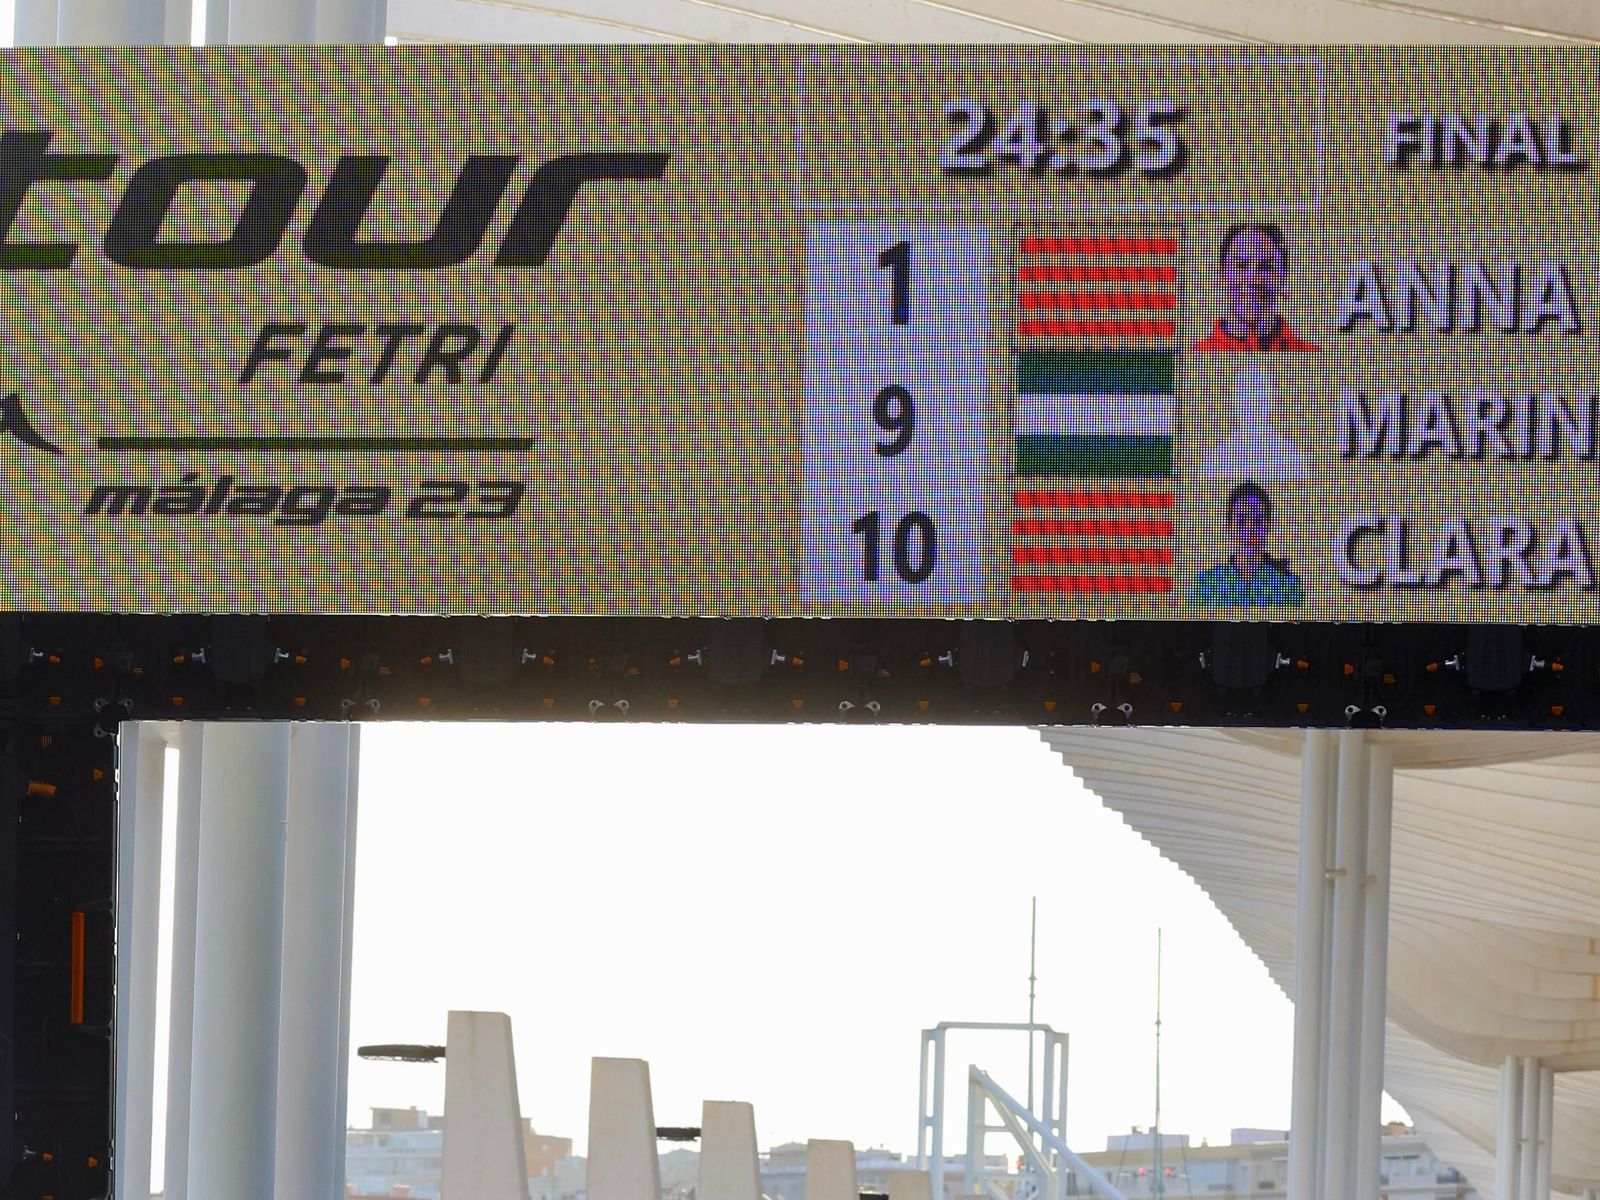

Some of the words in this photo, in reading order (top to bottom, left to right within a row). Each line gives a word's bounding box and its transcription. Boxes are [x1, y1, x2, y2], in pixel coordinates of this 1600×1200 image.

[941, 98, 1189, 177] 24:35
[1382, 111, 1587, 169] FINAL
[0, 131, 671, 269] tour
[877, 240, 912, 325] 1
[1338, 257, 1583, 334] ANNA
[239, 322, 515, 384] FETRI
[873, 385, 916, 458] 9
[1336, 387, 1599, 462] MARIN
[85, 474, 391, 526] málaga
[405, 481, 526, 519] 23
[851, 510, 937, 585] 10
[1332, 514, 1600, 592] CLARA
